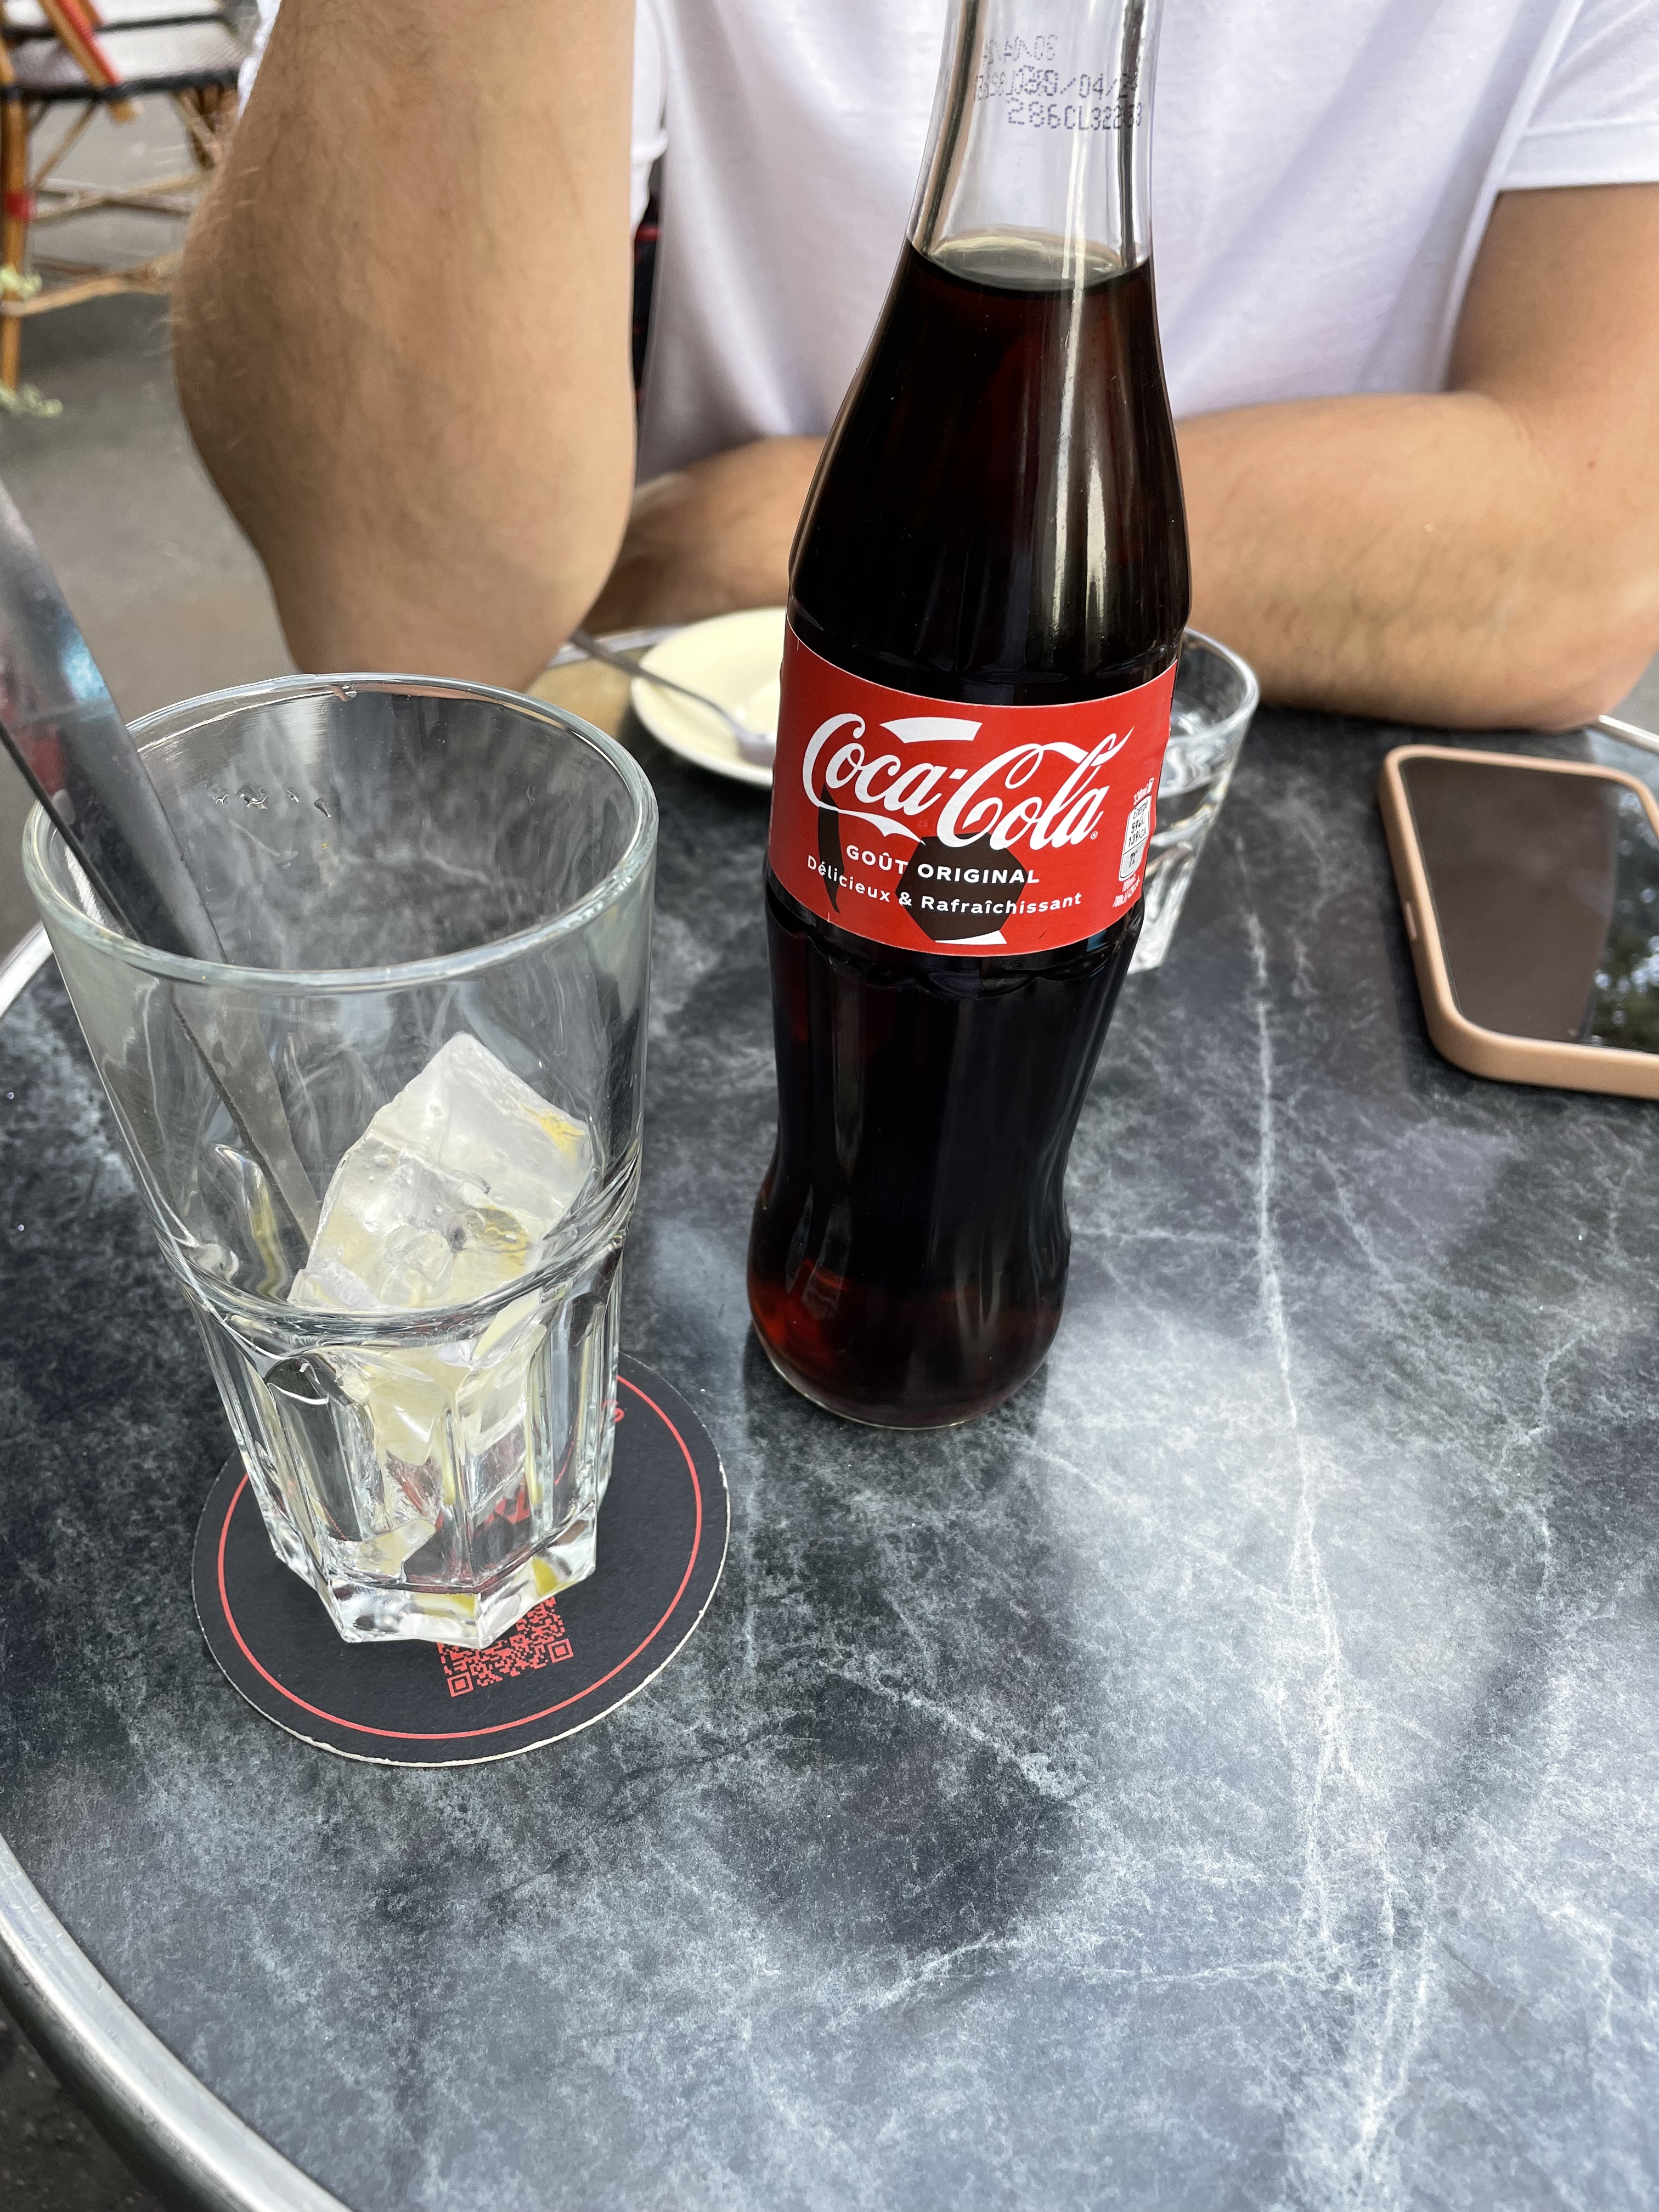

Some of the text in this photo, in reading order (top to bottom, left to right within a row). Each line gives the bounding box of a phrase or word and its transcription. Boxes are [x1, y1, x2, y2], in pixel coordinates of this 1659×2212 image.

[803, 713, 1134, 850] Coca-Cola
[808, 854, 1082, 915] Délicieux & Rafraîchissant
[846, 844, 1040, 884] GOÛT ORIGINAL
